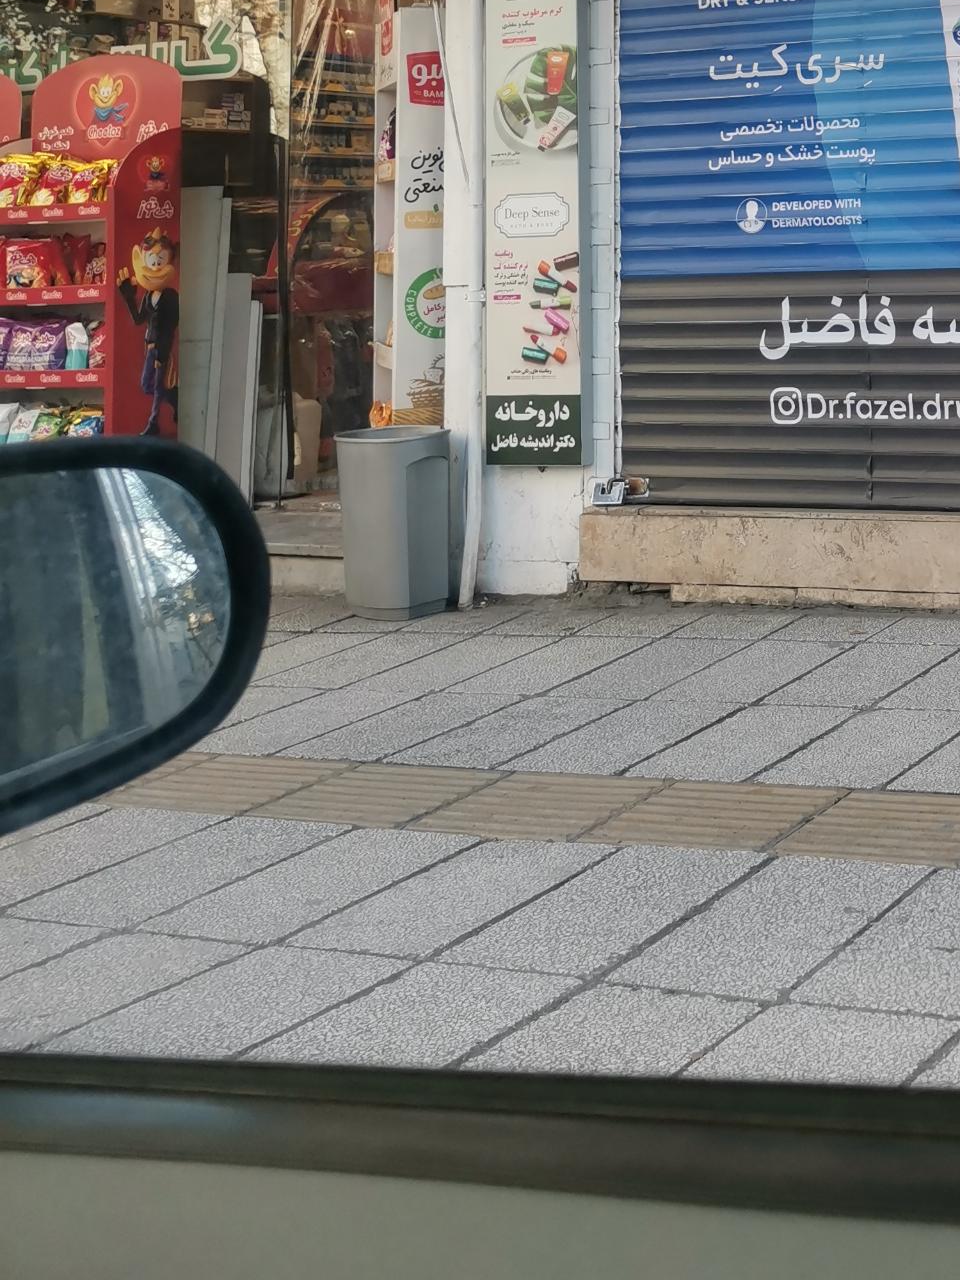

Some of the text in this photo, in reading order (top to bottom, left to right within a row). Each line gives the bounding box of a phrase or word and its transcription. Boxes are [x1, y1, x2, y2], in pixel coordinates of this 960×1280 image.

[87, 124, 121, 140] Cheetoz
[719, 116, 861, 142] محصولات تخصصی
[708, 143, 876, 171] پوست خشک و حساس
[504, 206, 560, 221] Deep Sense
[771, 198, 862, 212] DEVELOPED WITH
[771, 214, 863, 228] DERMATOLOGISTS
[758, 293, 896, 360] فاضل
[494, 400, 570, 428] داروخانه
[490, 432, 576, 452] دکتر اندیشه فاضل
